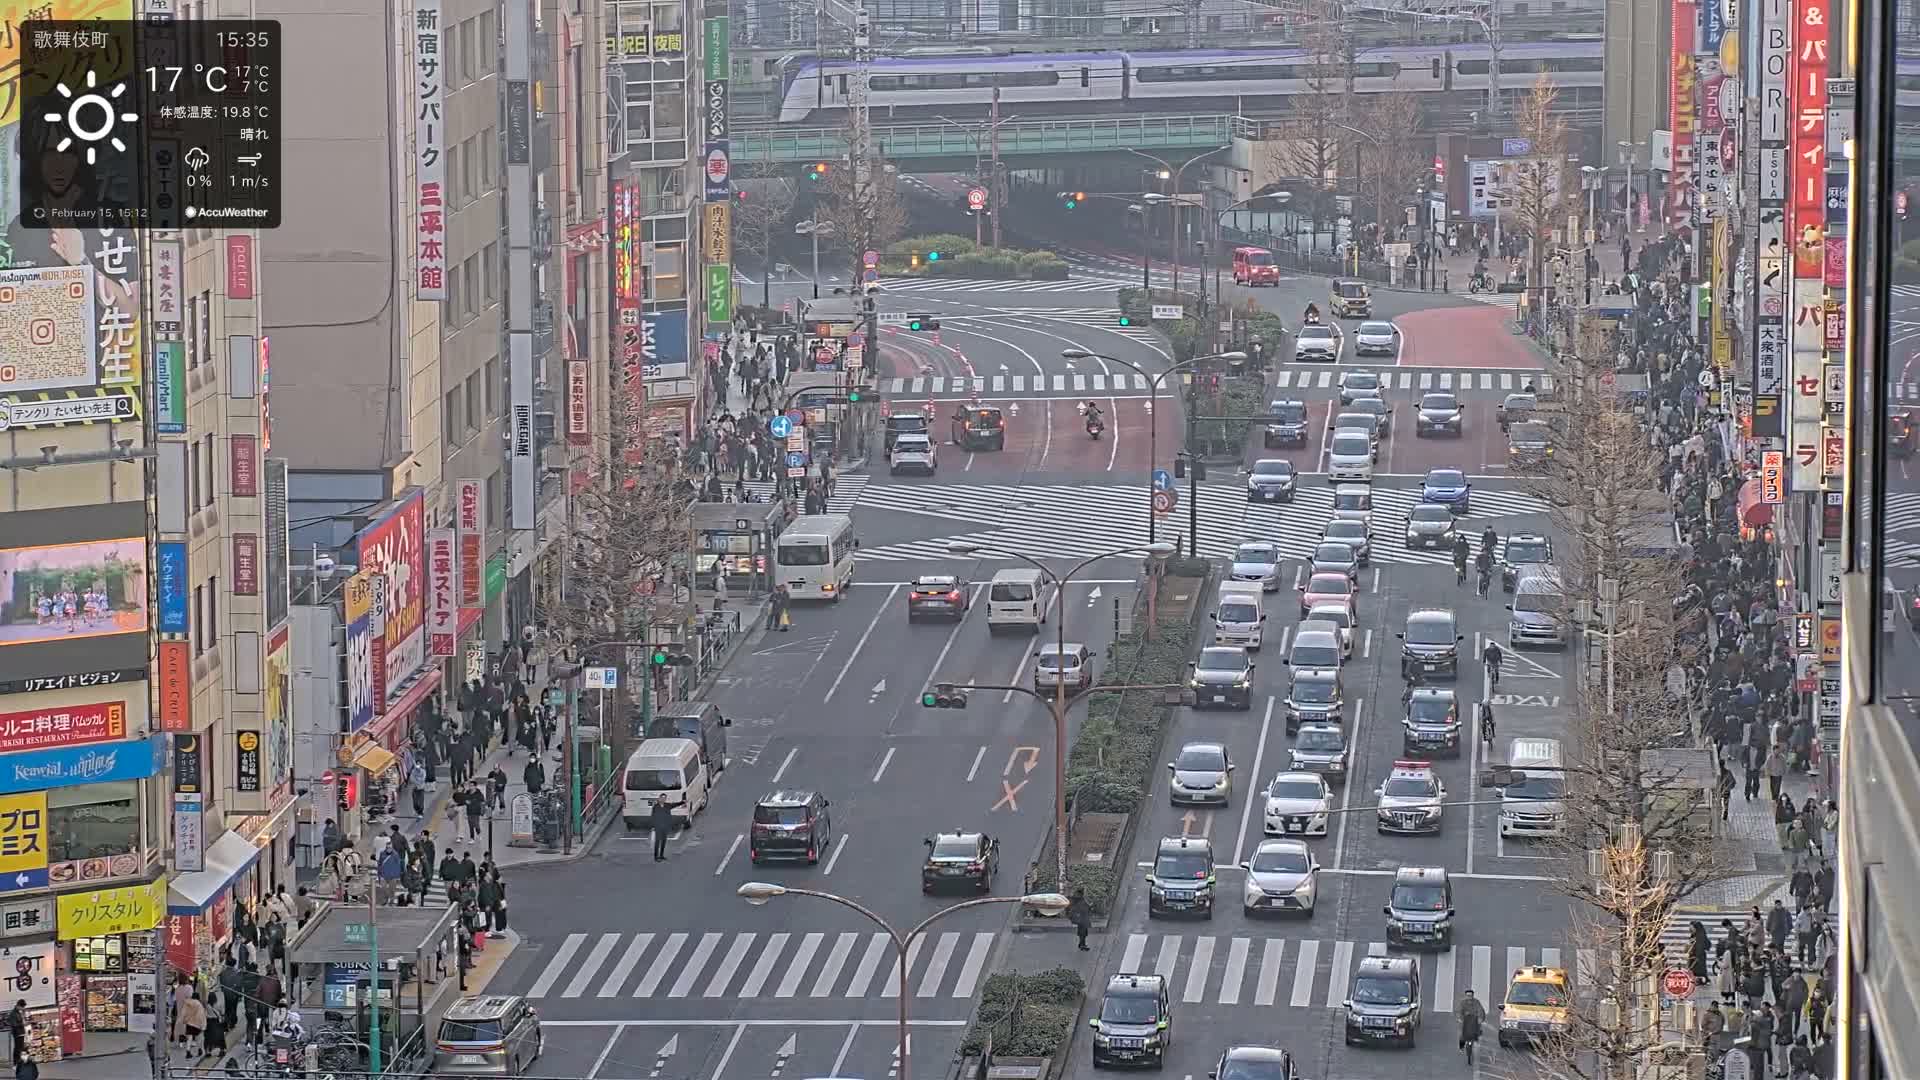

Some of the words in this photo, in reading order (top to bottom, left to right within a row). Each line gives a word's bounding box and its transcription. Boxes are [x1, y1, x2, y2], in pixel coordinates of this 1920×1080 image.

[655, 34, 682, 52] 夜間
[417, 9, 440, 167] 新宿サンパーク
[1707, 85, 1719, 118] アコム
[420, 183, 443, 289] 三平本館
[712, 273, 725, 312] レイク
[159, 322, 177, 331] 3F
[1760, 327, 1775, 381] 大衆酒場
[158, 351, 170, 412] FamilyMart
[1796, 306, 1822, 467] パセラ
[15, 408, 49, 420] テンクリ
[55, 402, 112, 417] たいせい先生
[515, 404, 529, 457] HOMEGAME
[463, 485, 474, 529] GAME
[374, 577, 383, 618] 389
[434, 540, 451, 627] 三平ストア
[1798, 618, 1811, 647] パセラ
[25, 674, 76, 691] リアエイド
[79, 671, 121, 686] ビジョン
[26, 733, 69, 745] RESTAURANT
[1, 808, 41, 830] プロ
[1, 833, 41, 856] ミス
[5, 909, 41, 930] 囲碁
[71, 900, 143, 925] クリスタル
[328, 989, 344, 1002] 12
